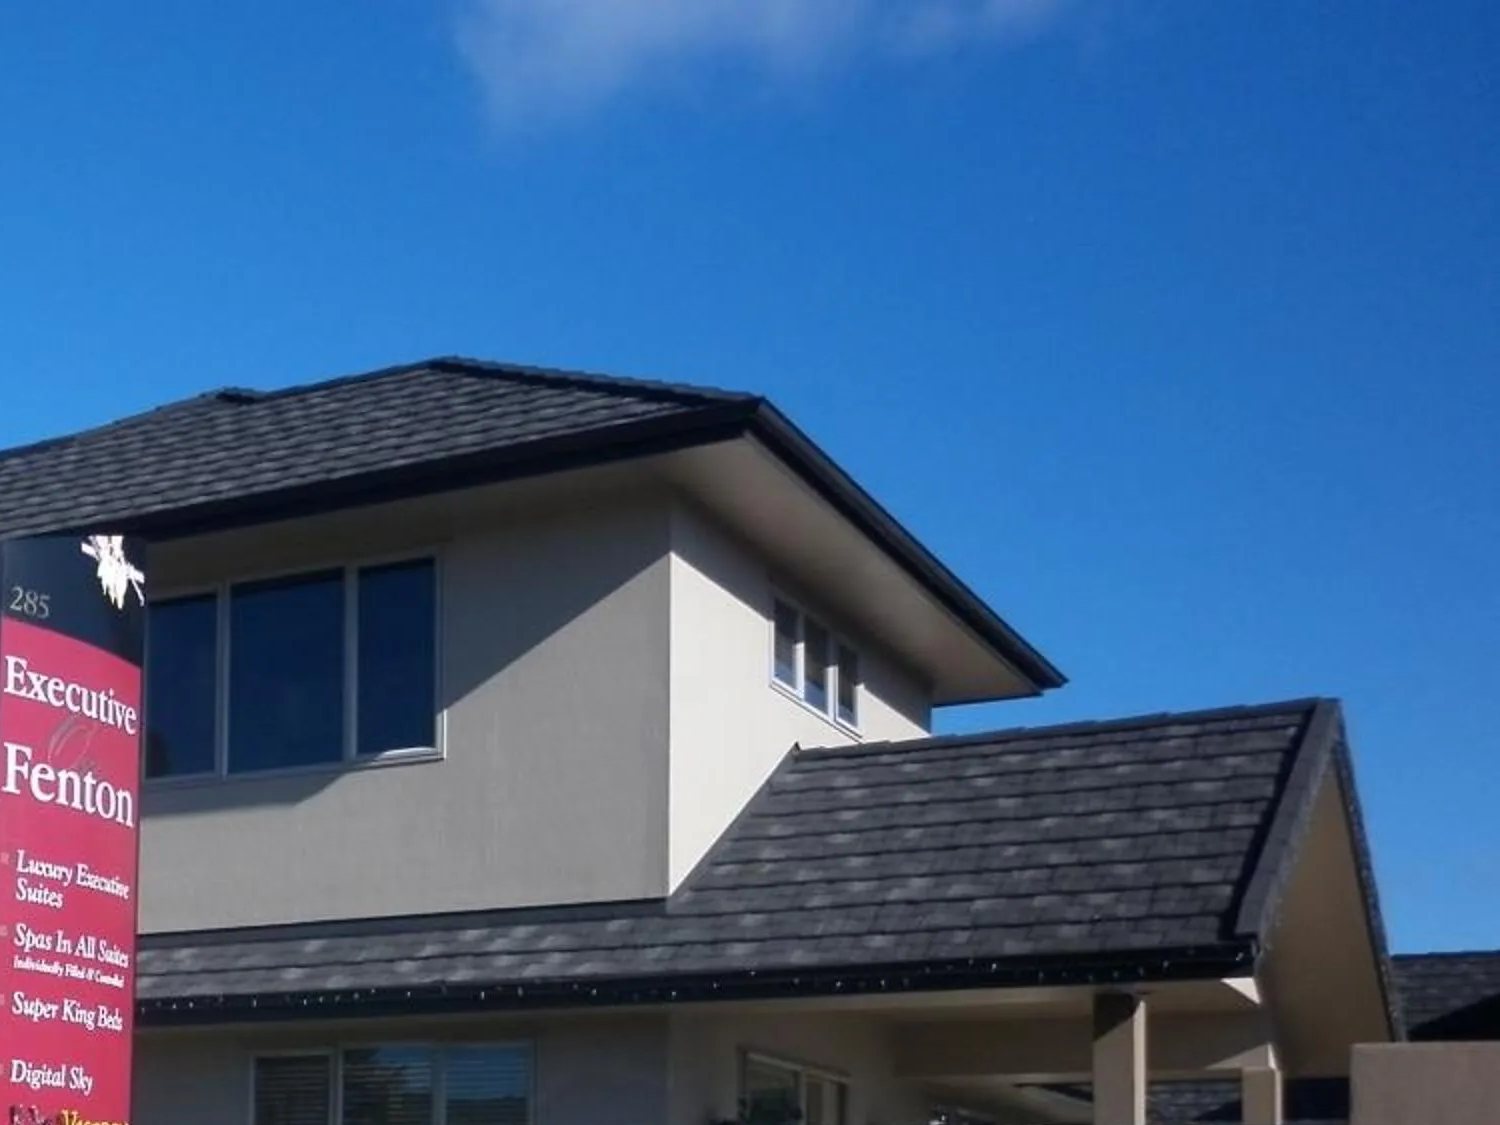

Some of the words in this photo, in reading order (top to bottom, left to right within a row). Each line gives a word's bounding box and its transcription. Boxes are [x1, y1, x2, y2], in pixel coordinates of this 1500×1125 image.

[9, 586, 51, 618] 285
[3, 655, 138, 735] Executive
[2, 742, 136, 829] Fenton
[15, 877, 64, 909] Suites
[16, 849, 73, 887] Luxury
[75, 863, 130, 900] Executive
[13, 923, 52, 953] Spas
[55, 930, 72, 955] In
[74, 936, 96, 960] All
[97, 938, 130, 969] Suites
[11, 991, 60, 1022] Super
[61, 998, 96, 1030] King
[97, 1005, 124, 1032] Beds
[10, 1059, 67, 1090] Digital
[69, 1066, 94, 1096] Sky
